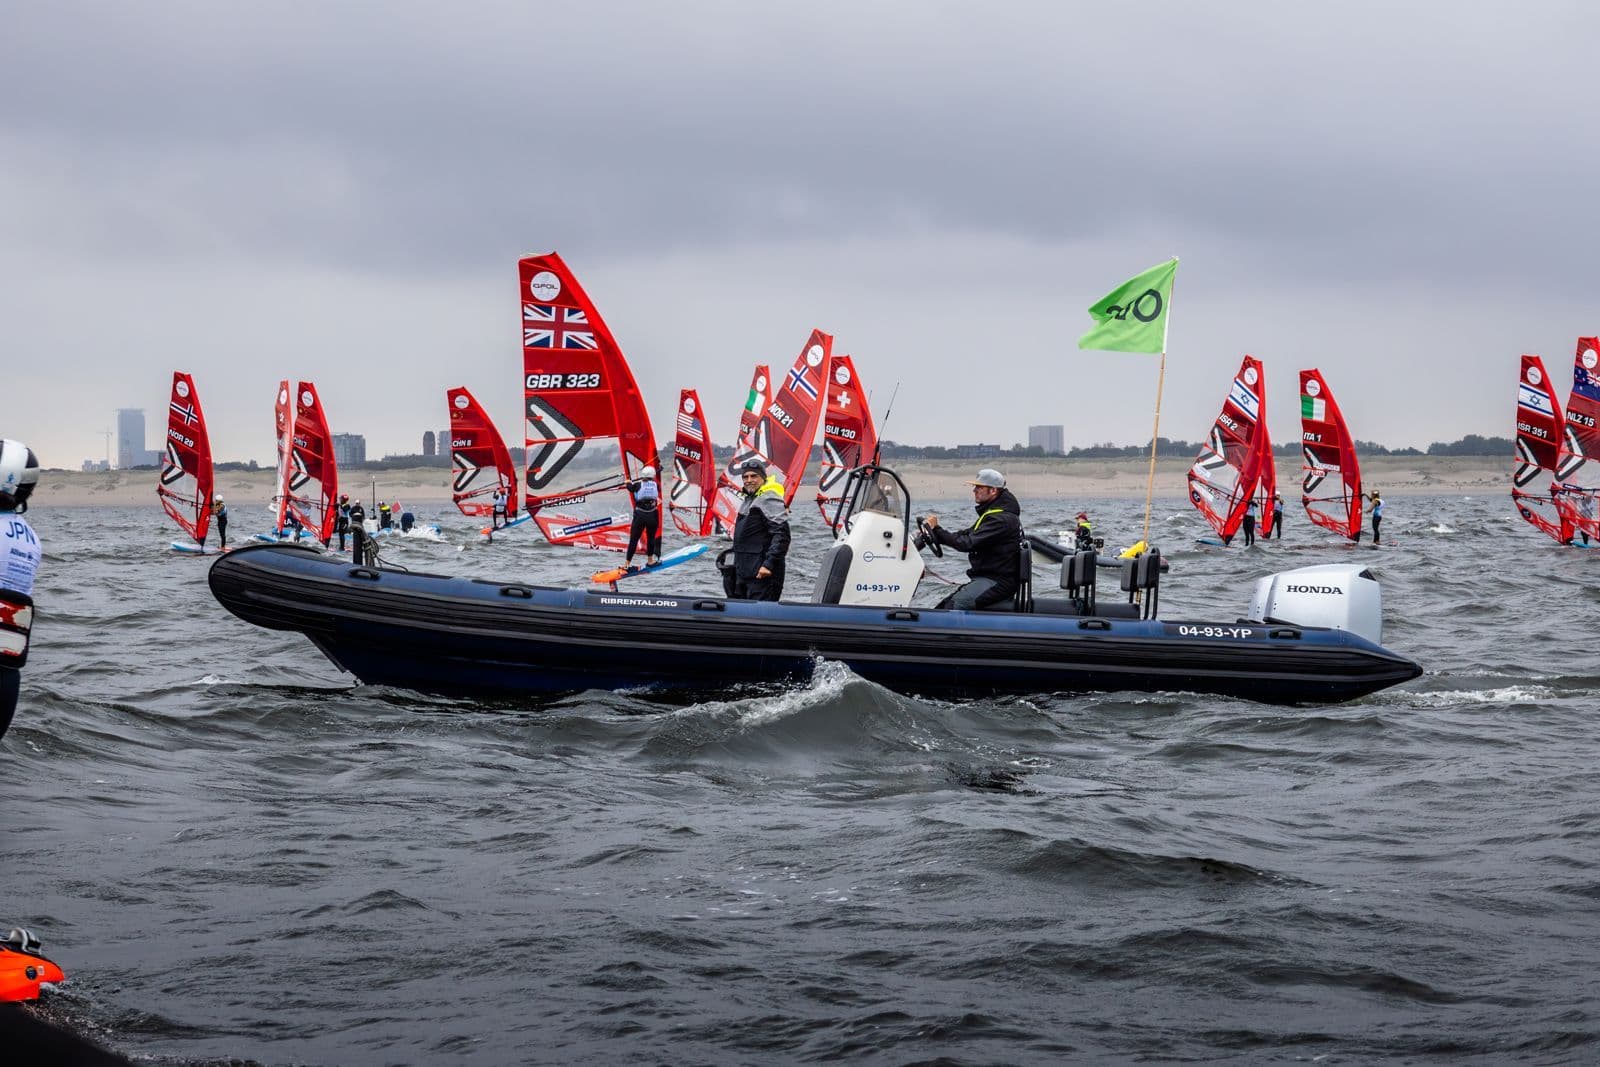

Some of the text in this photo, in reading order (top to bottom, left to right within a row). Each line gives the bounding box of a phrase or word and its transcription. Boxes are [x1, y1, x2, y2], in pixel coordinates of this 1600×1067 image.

[526, 374, 600, 389] GBR 323
[767, 402, 794, 428] NOR 21
[1584, 416, 1595, 427] 15
[1219, 413, 1239, 431] ISR 2
[168, 429, 184, 442] NOR
[825, 424, 856, 440] SUI 130
[1303, 431, 1322, 442] ITA 1
[1517, 422, 1548, 438] ISR 351
[675, 445, 689, 457] USA
[5, 521, 36, 545] JPN
[856, 583, 901, 592] 04-93-YP
[1286, 584, 1344, 595] HONDA
[600, 597, 678, 608] RIBRENTAL.ORG
[1178, 625, 1253, 639] 04-93-YP
